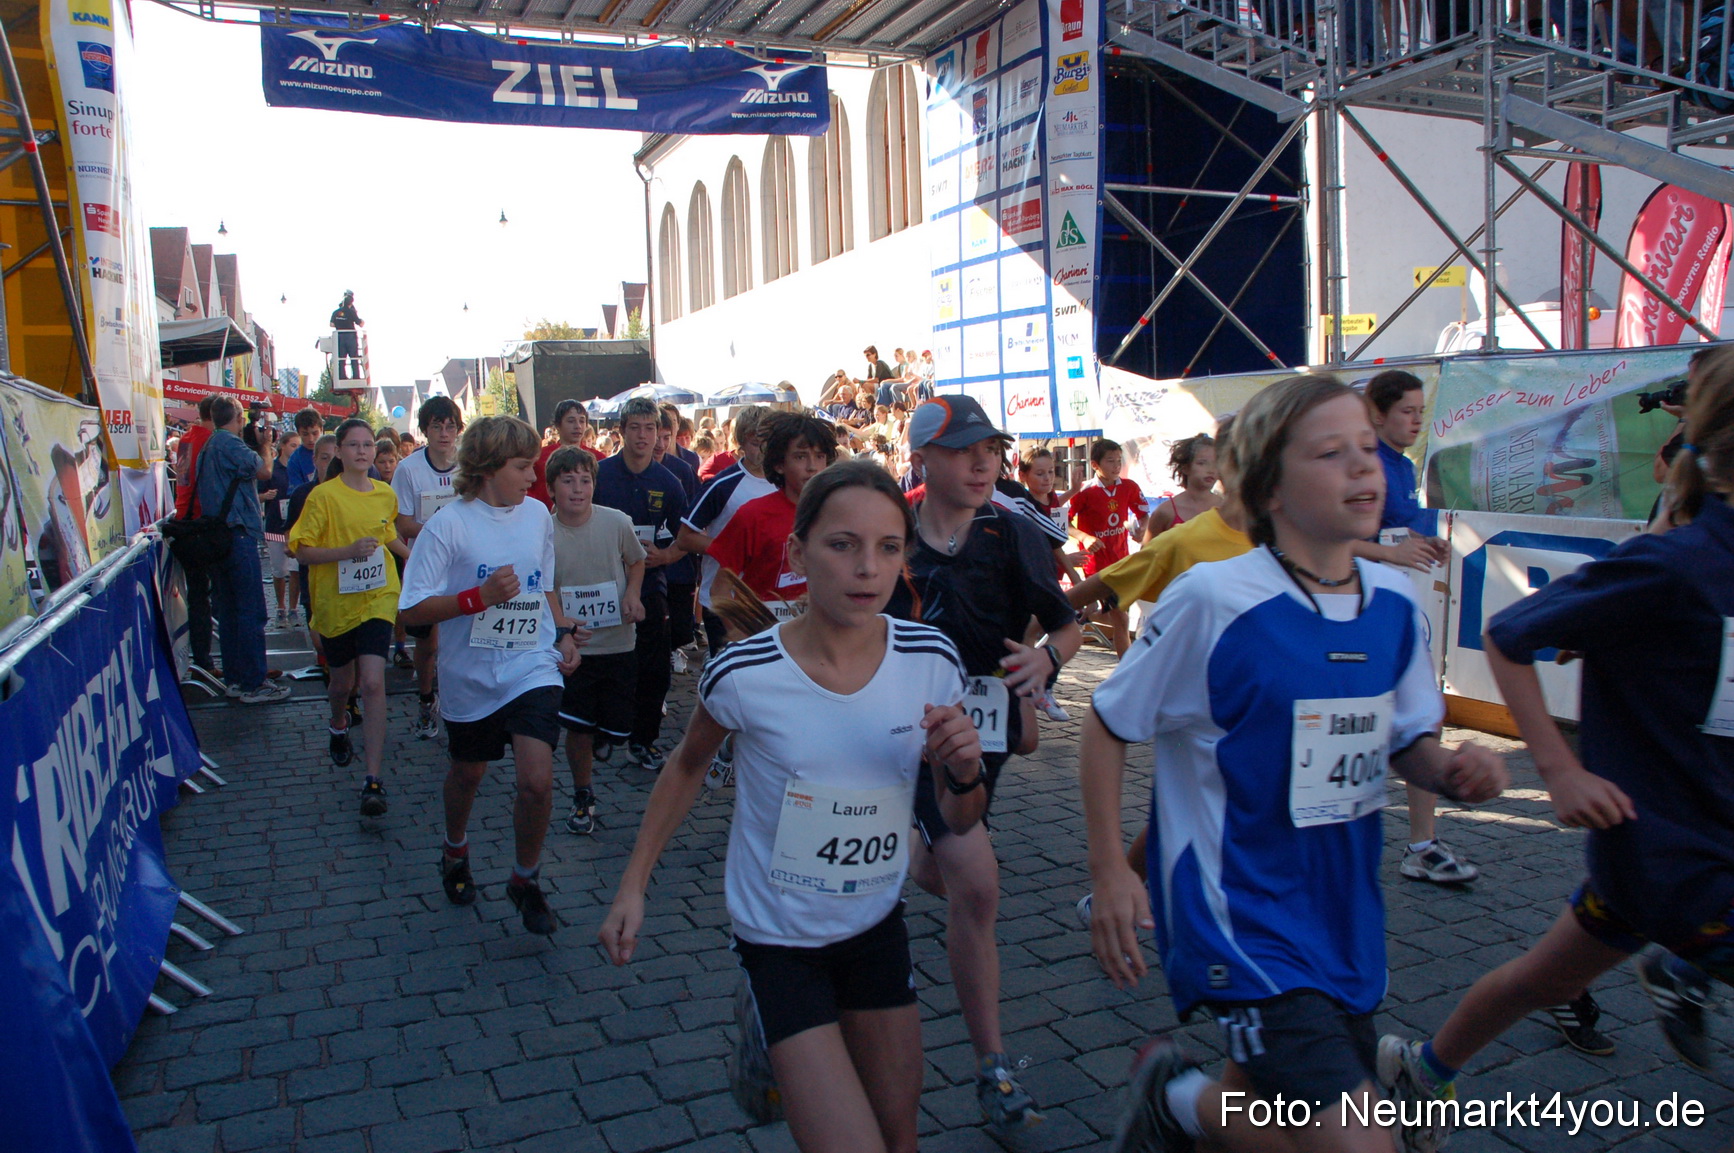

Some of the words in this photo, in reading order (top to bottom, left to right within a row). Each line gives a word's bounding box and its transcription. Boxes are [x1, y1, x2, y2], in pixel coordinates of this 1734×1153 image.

[72, 11, 110, 27] KANN
[279, 79, 382, 97] www.mizunoeurope.com
[491, 59, 638, 111] ZIEL
[731, 111, 818, 119] www.mizunoeurope.com
[71, 120, 113, 139] forte
[1695, 225, 1719, 261] Radio
[1054, 304, 1078, 317] swn
[240, 394, 260, 403] 6352
[1433, 389, 1511, 438] Wasser
[1515, 391, 1554, 407] zum
[1563, 360, 1627, 406] Leben
[341, 567, 347, 575] J
[353, 563, 383, 581] 4027
[476, 563, 488, 579] 6
[574, 589, 601, 599] Simon
[495, 599, 541, 611] Christoph
[565, 602, 571, 610] J
[578, 600, 616, 617] 4175
[478, 612, 486, 621] J
[492, 617, 537, 635] 4173
[961, 706, 998, 732] 01
[890, 724, 913, 735] adidas
[1299, 748, 1312, 768] J
[832, 801, 878, 816] Laura
[816, 831, 898, 866] 4209
